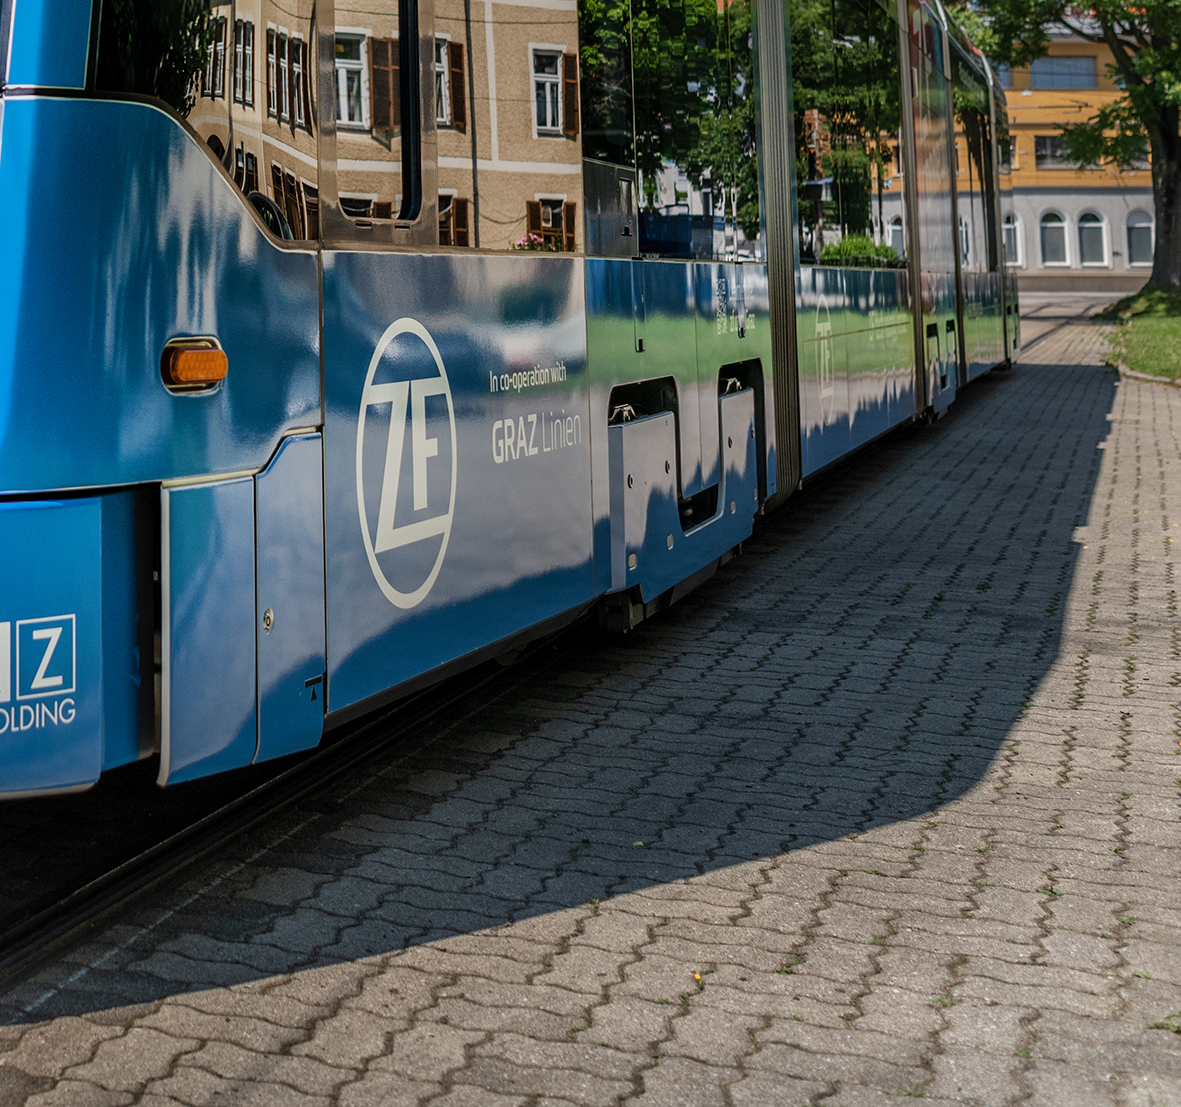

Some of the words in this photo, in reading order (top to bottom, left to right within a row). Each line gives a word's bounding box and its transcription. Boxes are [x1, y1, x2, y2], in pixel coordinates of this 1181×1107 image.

[489, 370, 498, 393] In
[499, 364, 547, 393] co-operation
[548, 361, 567, 386] with
[492, 413, 539, 464] GRAZ
[541, 411, 582, 454] Linien
[360, 366, 455, 566] ZF
